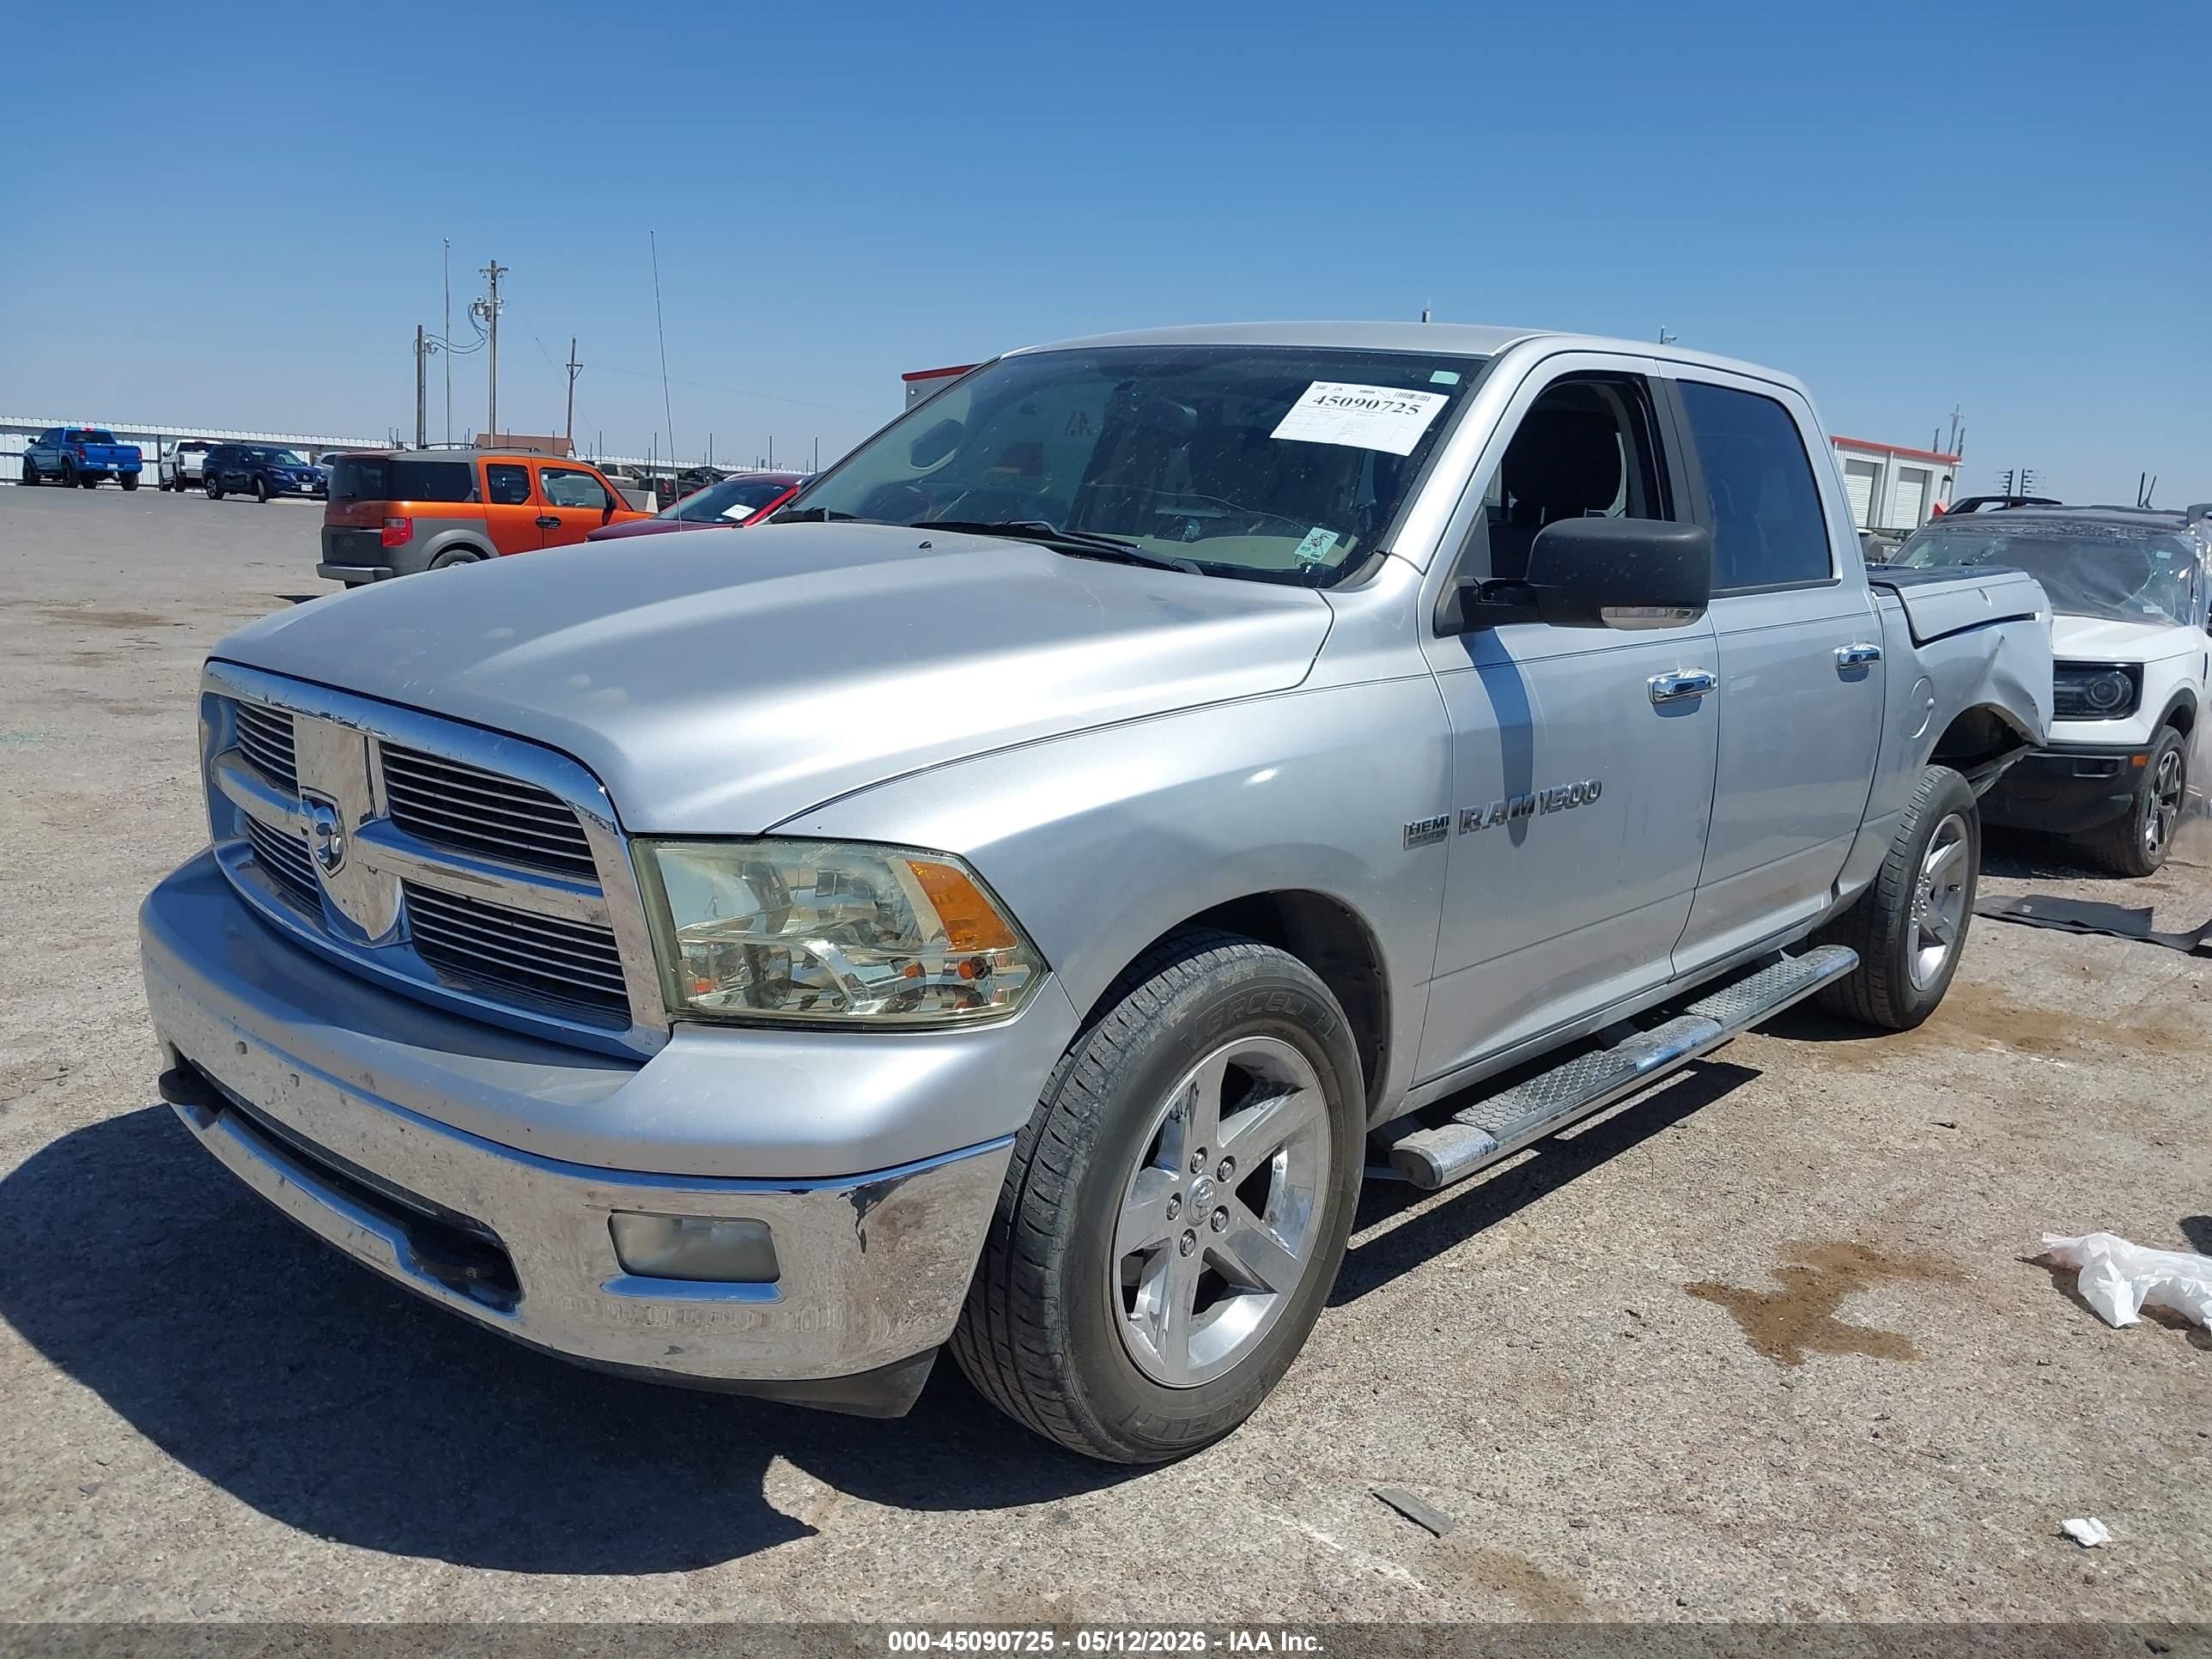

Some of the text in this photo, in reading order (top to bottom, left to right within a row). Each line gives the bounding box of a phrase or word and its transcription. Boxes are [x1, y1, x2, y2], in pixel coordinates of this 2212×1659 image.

[1312, 394, 1422, 416] 45090725
[1459, 779, 1602, 834] RAM 1500
[1409, 815, 1449, 836] HEMI
